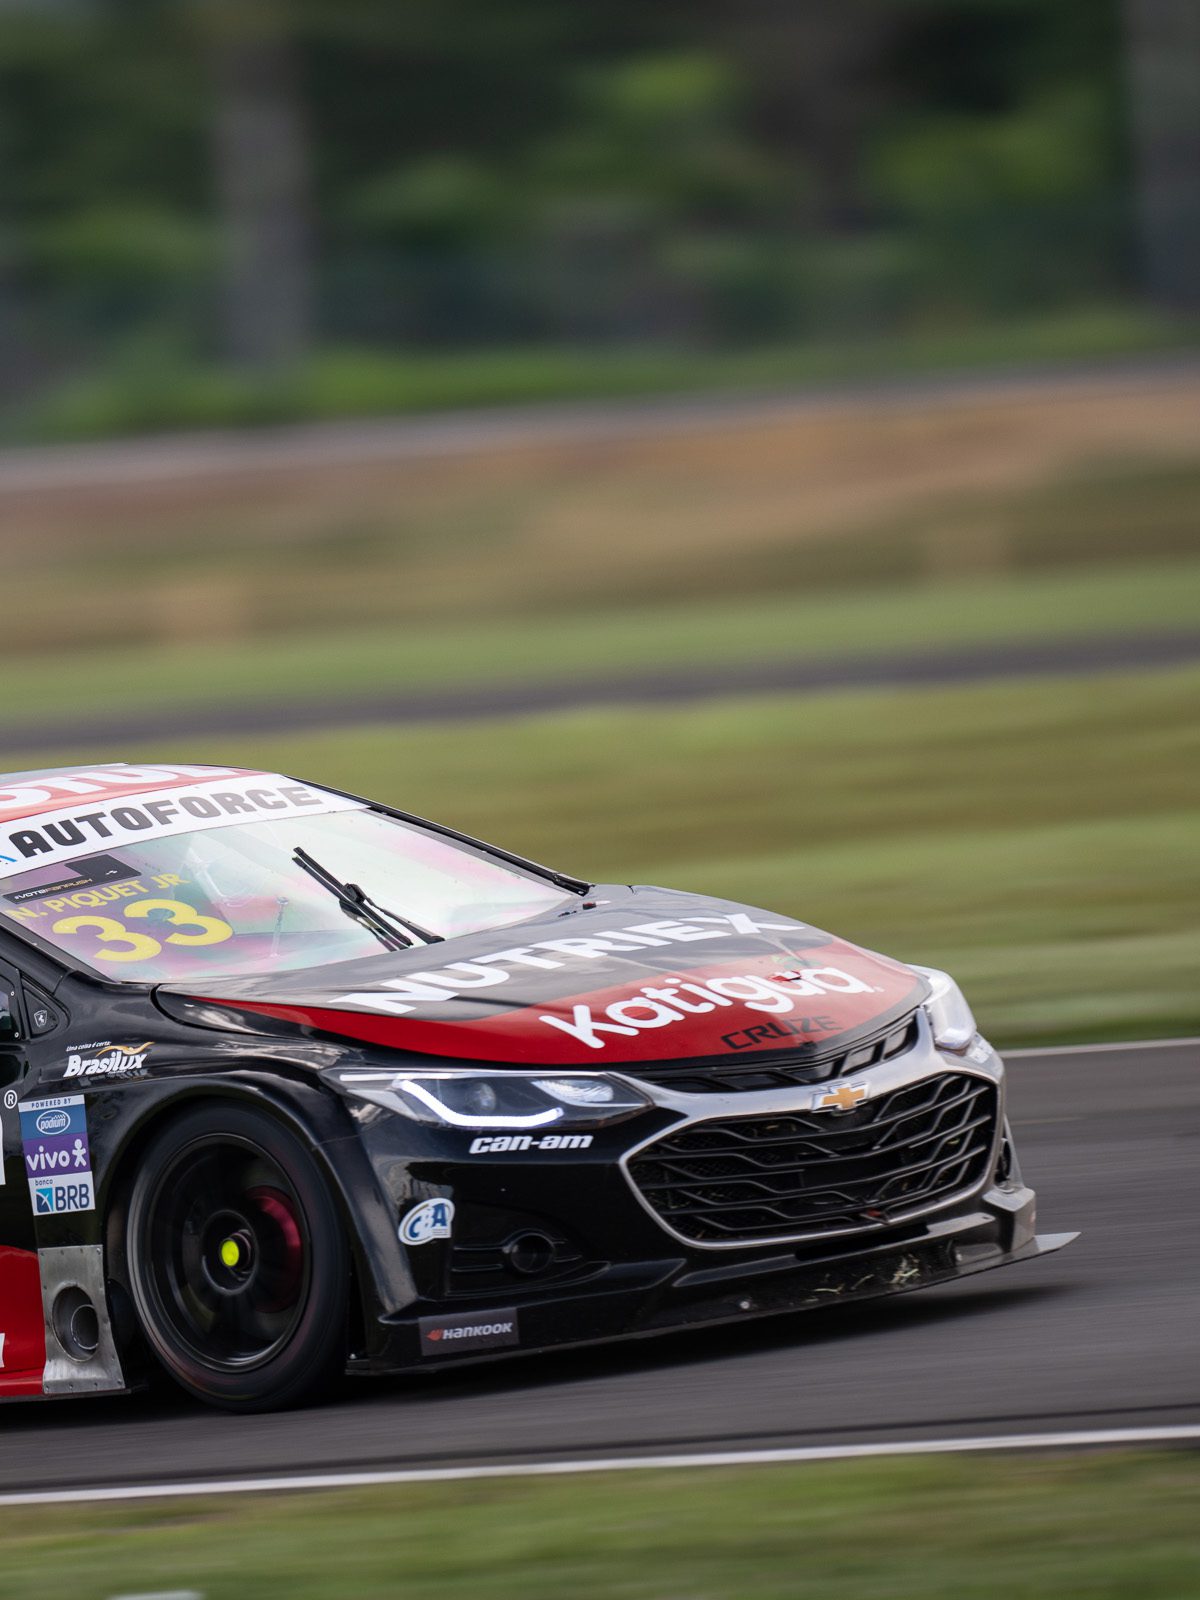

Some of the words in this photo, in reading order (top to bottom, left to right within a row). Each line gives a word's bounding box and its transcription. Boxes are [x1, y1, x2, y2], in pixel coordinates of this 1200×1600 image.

[7, 785, 322, 858] AUTOFORCE
[49, 880, 150, 913] PIQUET
[151, 872, 192, 889] JR
[52, 899, 234, 962] 33
[329, 912, 804, 1014] NUTRIEX
[720, 1016, 844, 1050] CRUZE
[63, 1051, 147, 1077] Brasilux
[31, 1098, 61, 1108] POWERED
[40, 1117, 66, 1130] podium
[469, 1135, 593, 1154] can-am
[27, 1146, 70, 1171] vivo
[55, 1184, 90, 1211] BRB
